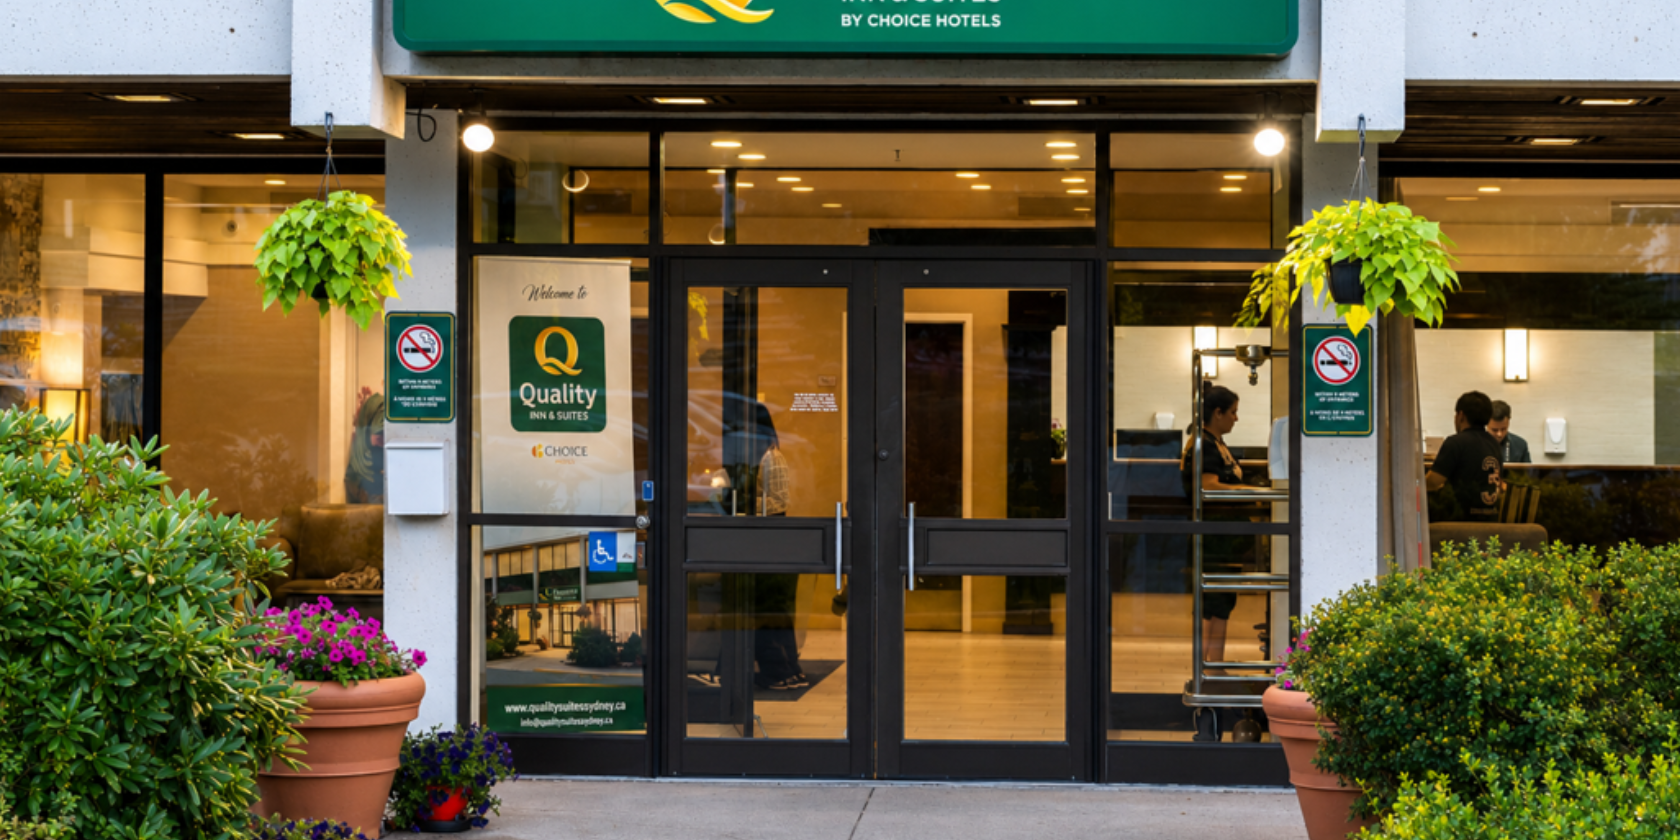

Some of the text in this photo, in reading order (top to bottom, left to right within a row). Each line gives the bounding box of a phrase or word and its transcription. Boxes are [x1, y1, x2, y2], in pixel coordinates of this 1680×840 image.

[840, 13, 1001, 27] BY CHOICE HOTELS
[522, 284, 589, 301] Welcome to
[519, 382, 597, 409] Quality
[529, 411, 589, 421] INN & SUITES
[544, 445, 588, 457] CHOICE
[1481, 456, 1500, 506] 3
